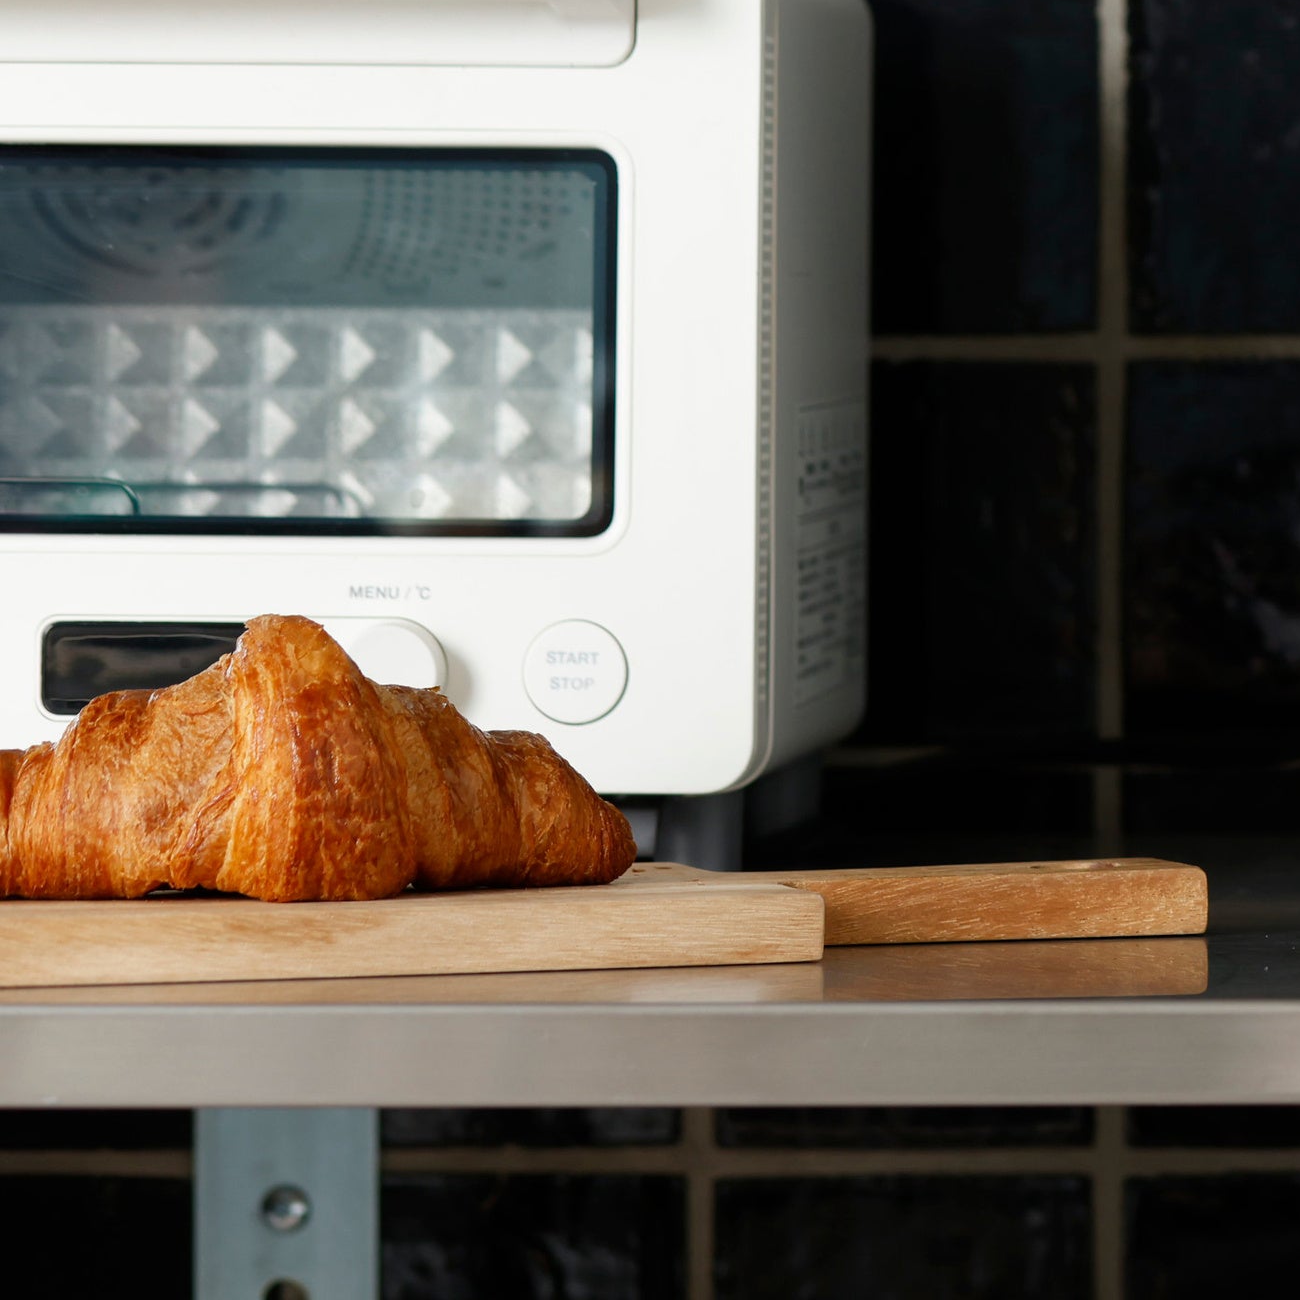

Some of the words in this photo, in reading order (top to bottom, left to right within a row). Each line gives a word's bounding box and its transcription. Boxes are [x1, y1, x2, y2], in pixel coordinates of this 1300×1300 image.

[349, 585, 400, 599] MENU
[546, 650, 599, 665] START
[550, 675, 594, 690] STOP
